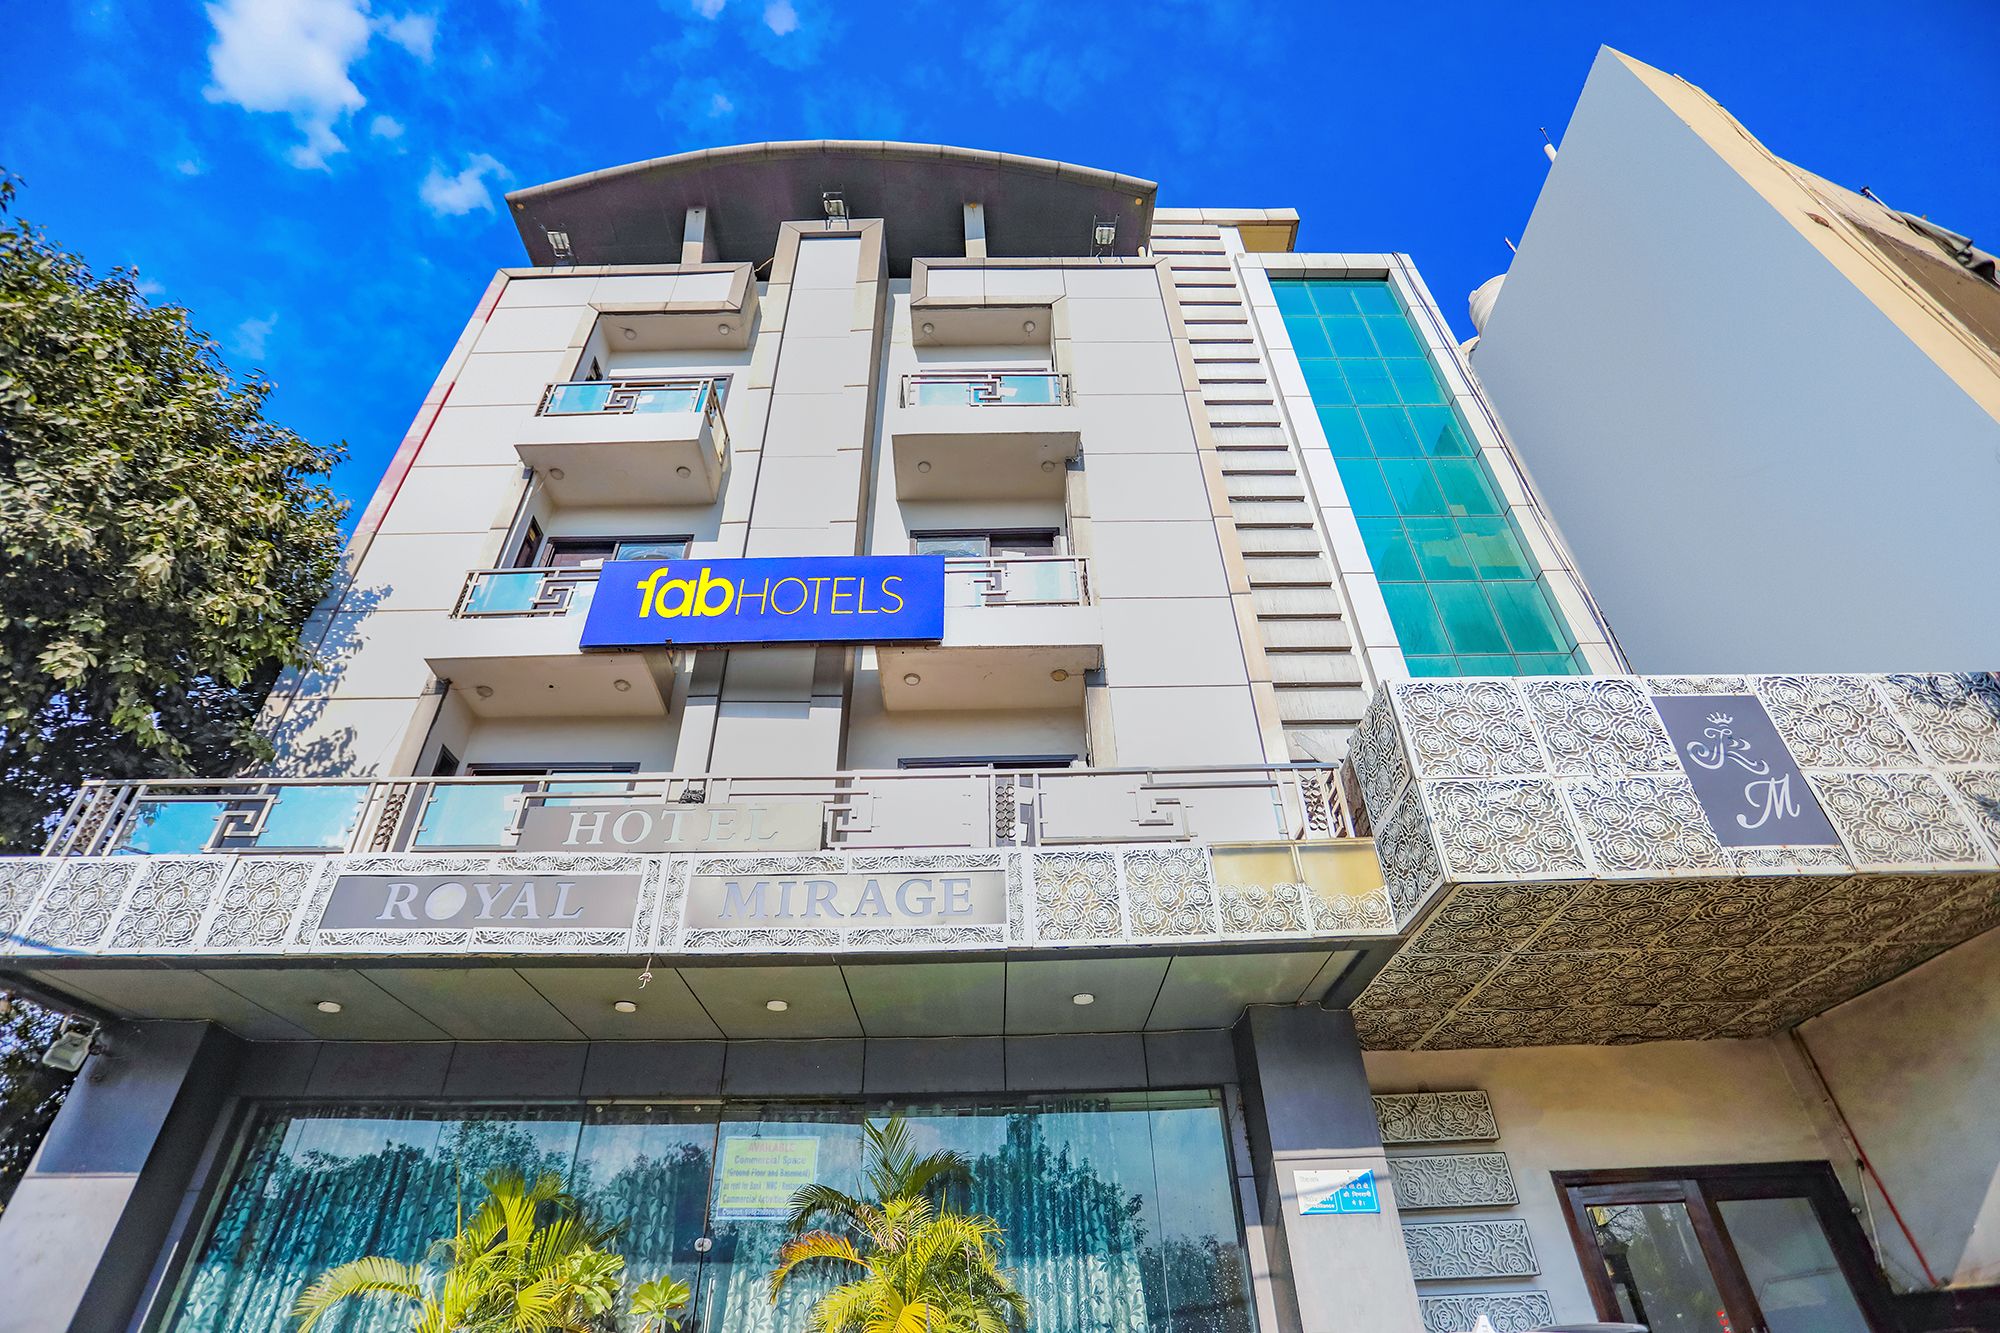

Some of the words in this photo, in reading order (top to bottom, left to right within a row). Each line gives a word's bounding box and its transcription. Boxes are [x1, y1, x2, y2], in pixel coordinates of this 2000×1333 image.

[561, 808, 778, 845] HOTEL
[375, 881, 584, 921] ROYAL
[718, 878, 974, 919] MIRAGE
[747, 1142, 797, 1153] AVAILABLE
[734, 1155, 781, 1165] Commercial
[782, 1156, 807, 1167] Space
